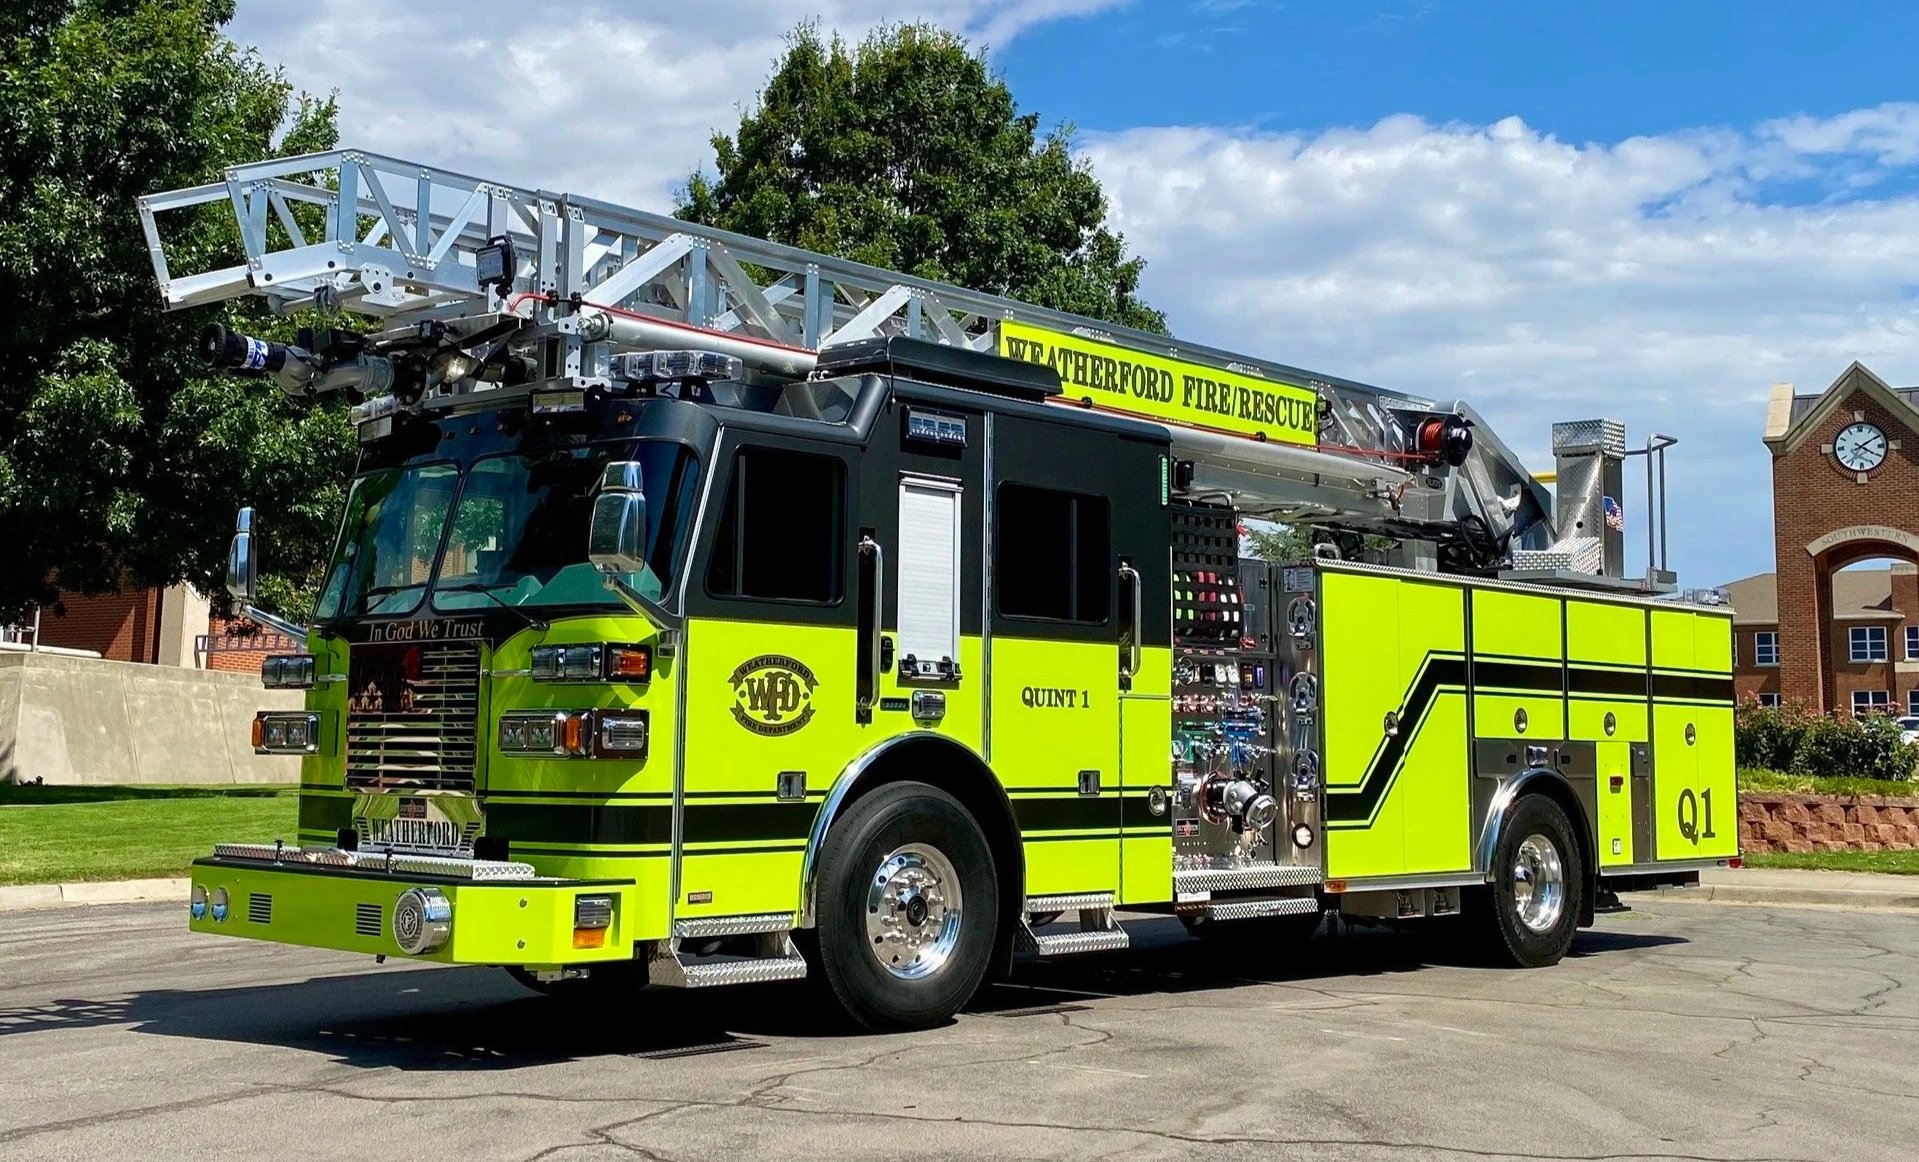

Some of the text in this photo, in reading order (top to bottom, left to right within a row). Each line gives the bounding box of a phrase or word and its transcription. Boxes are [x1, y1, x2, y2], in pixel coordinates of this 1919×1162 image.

[1006, 336, 1314, 431] WEATHERFORD FIRE/RESCUE
[1822, 528, 1909, 546] SOUTHWESTERN
[369, 619, 484, 641] In God We Trust
[739, 657, 810, 679] WEATHERFORD
[1021, 686, 1090, 709] QUINT 1
[740, 715, 806, 734] FIRE DEPARTMENT
[1678, 787, 1716, 846] Q1
[371, 818, 460, 846] WEATHERFORD
